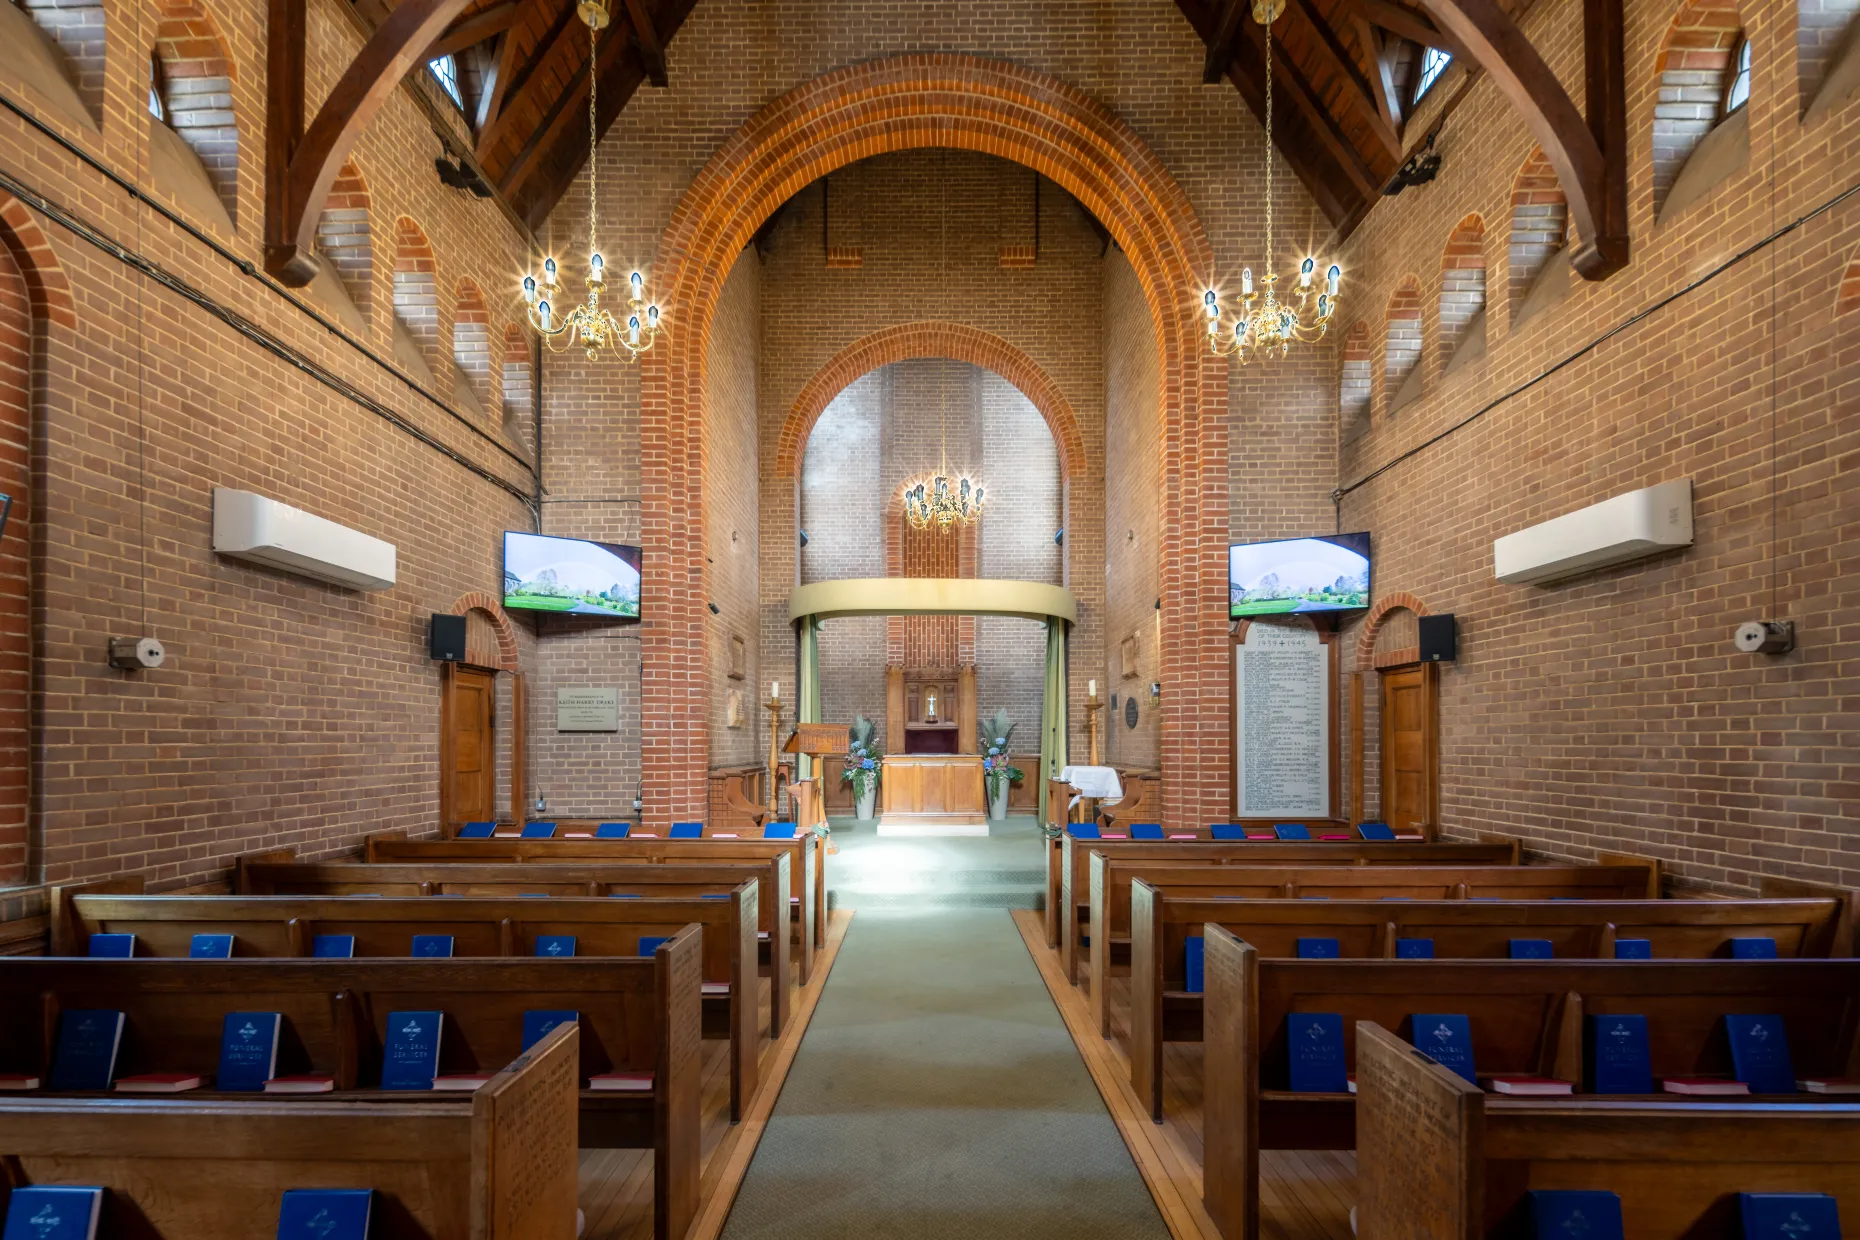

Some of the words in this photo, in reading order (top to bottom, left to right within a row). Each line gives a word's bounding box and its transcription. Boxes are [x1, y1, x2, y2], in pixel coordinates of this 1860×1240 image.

[1257, 640, 1277, 648] 1939
[1287, 640, 1307, 648] 1945
[1427, 1045, 1464, 1053] FUNERAL
[393, 1051, 428, 1059] SERVICES
